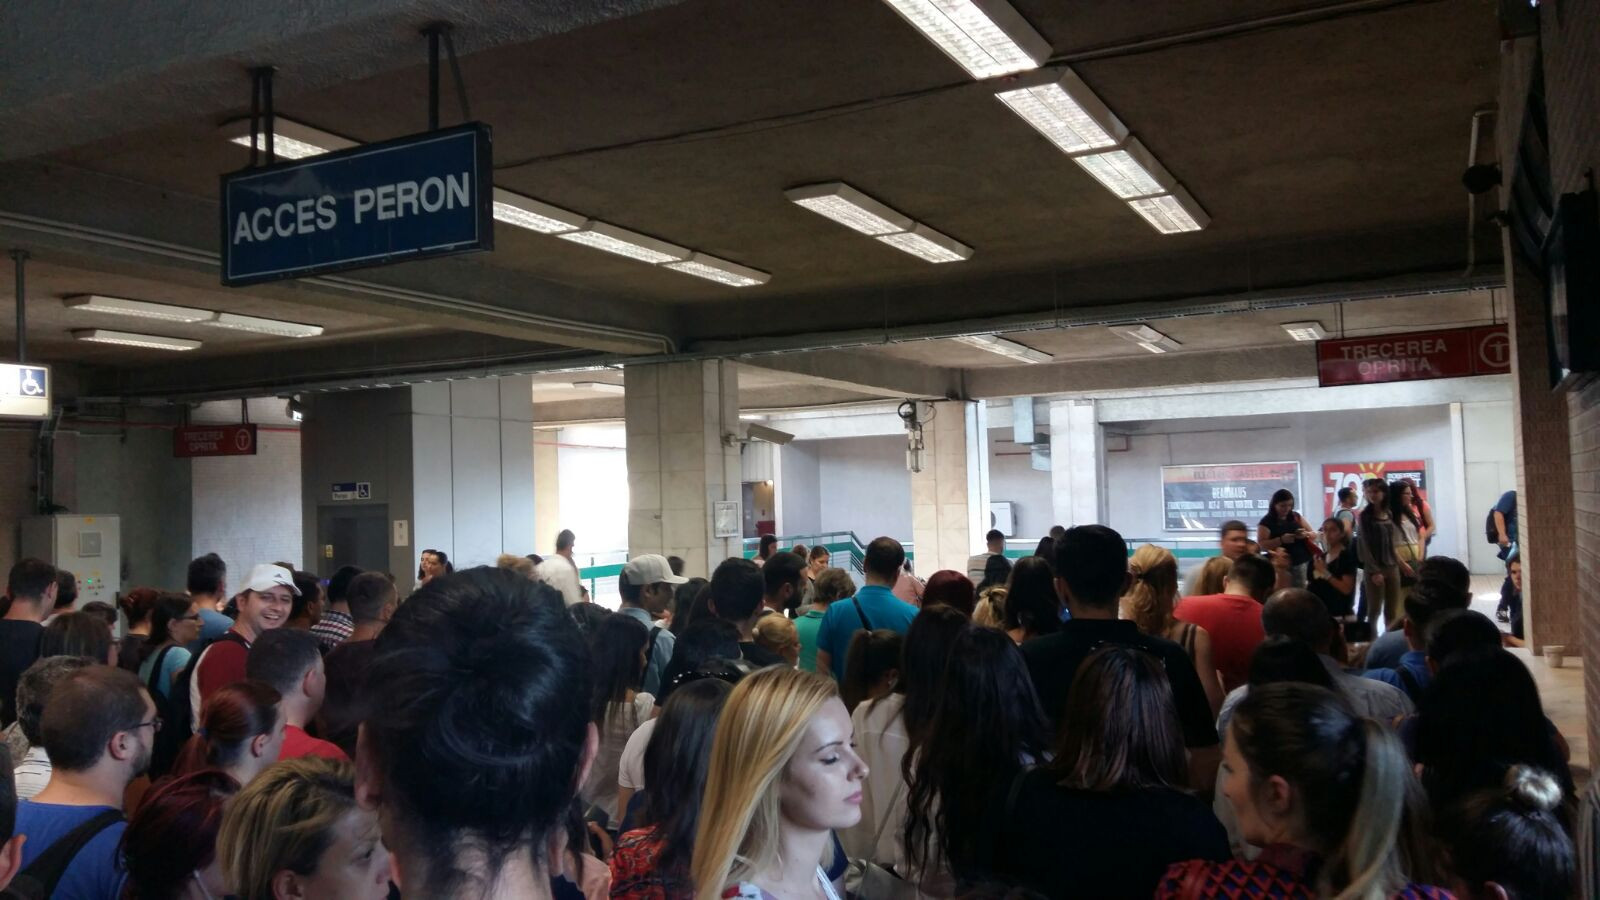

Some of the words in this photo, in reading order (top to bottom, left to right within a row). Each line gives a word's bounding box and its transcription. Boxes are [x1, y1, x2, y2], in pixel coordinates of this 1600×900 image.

[233, 195, 338, 245] ACCES
[353, 172, 470, 224] PERON
[1340, 338, 1448, 361] TRECEREA
[1358, 356, 1432, 376] OPRITA
